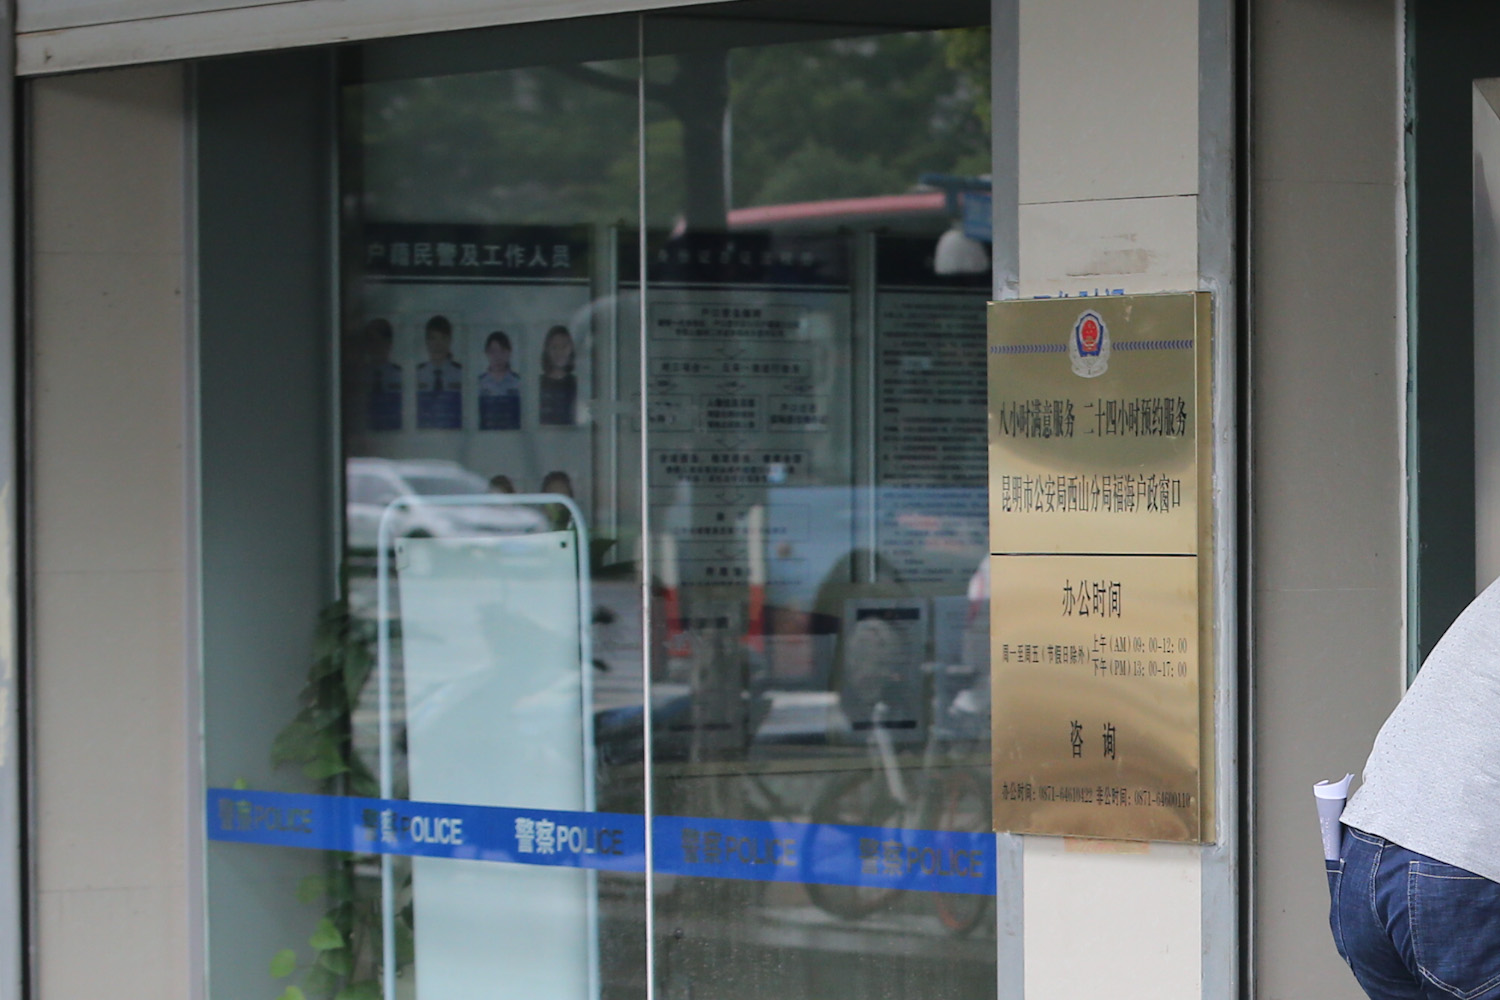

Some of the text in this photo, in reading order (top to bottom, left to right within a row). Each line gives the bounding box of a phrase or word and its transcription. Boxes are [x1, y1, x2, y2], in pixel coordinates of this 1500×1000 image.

[366, 242, 571, 268] 户籍民警及工作人员
[999, 397, 1188, 438] 八小时满意服务 二十四小时预约服务
[1001, 474, 1182, 514] 昆明市公安局西山分局福海户政窗口
[1062, 579, 1121, 618] 办公时间
